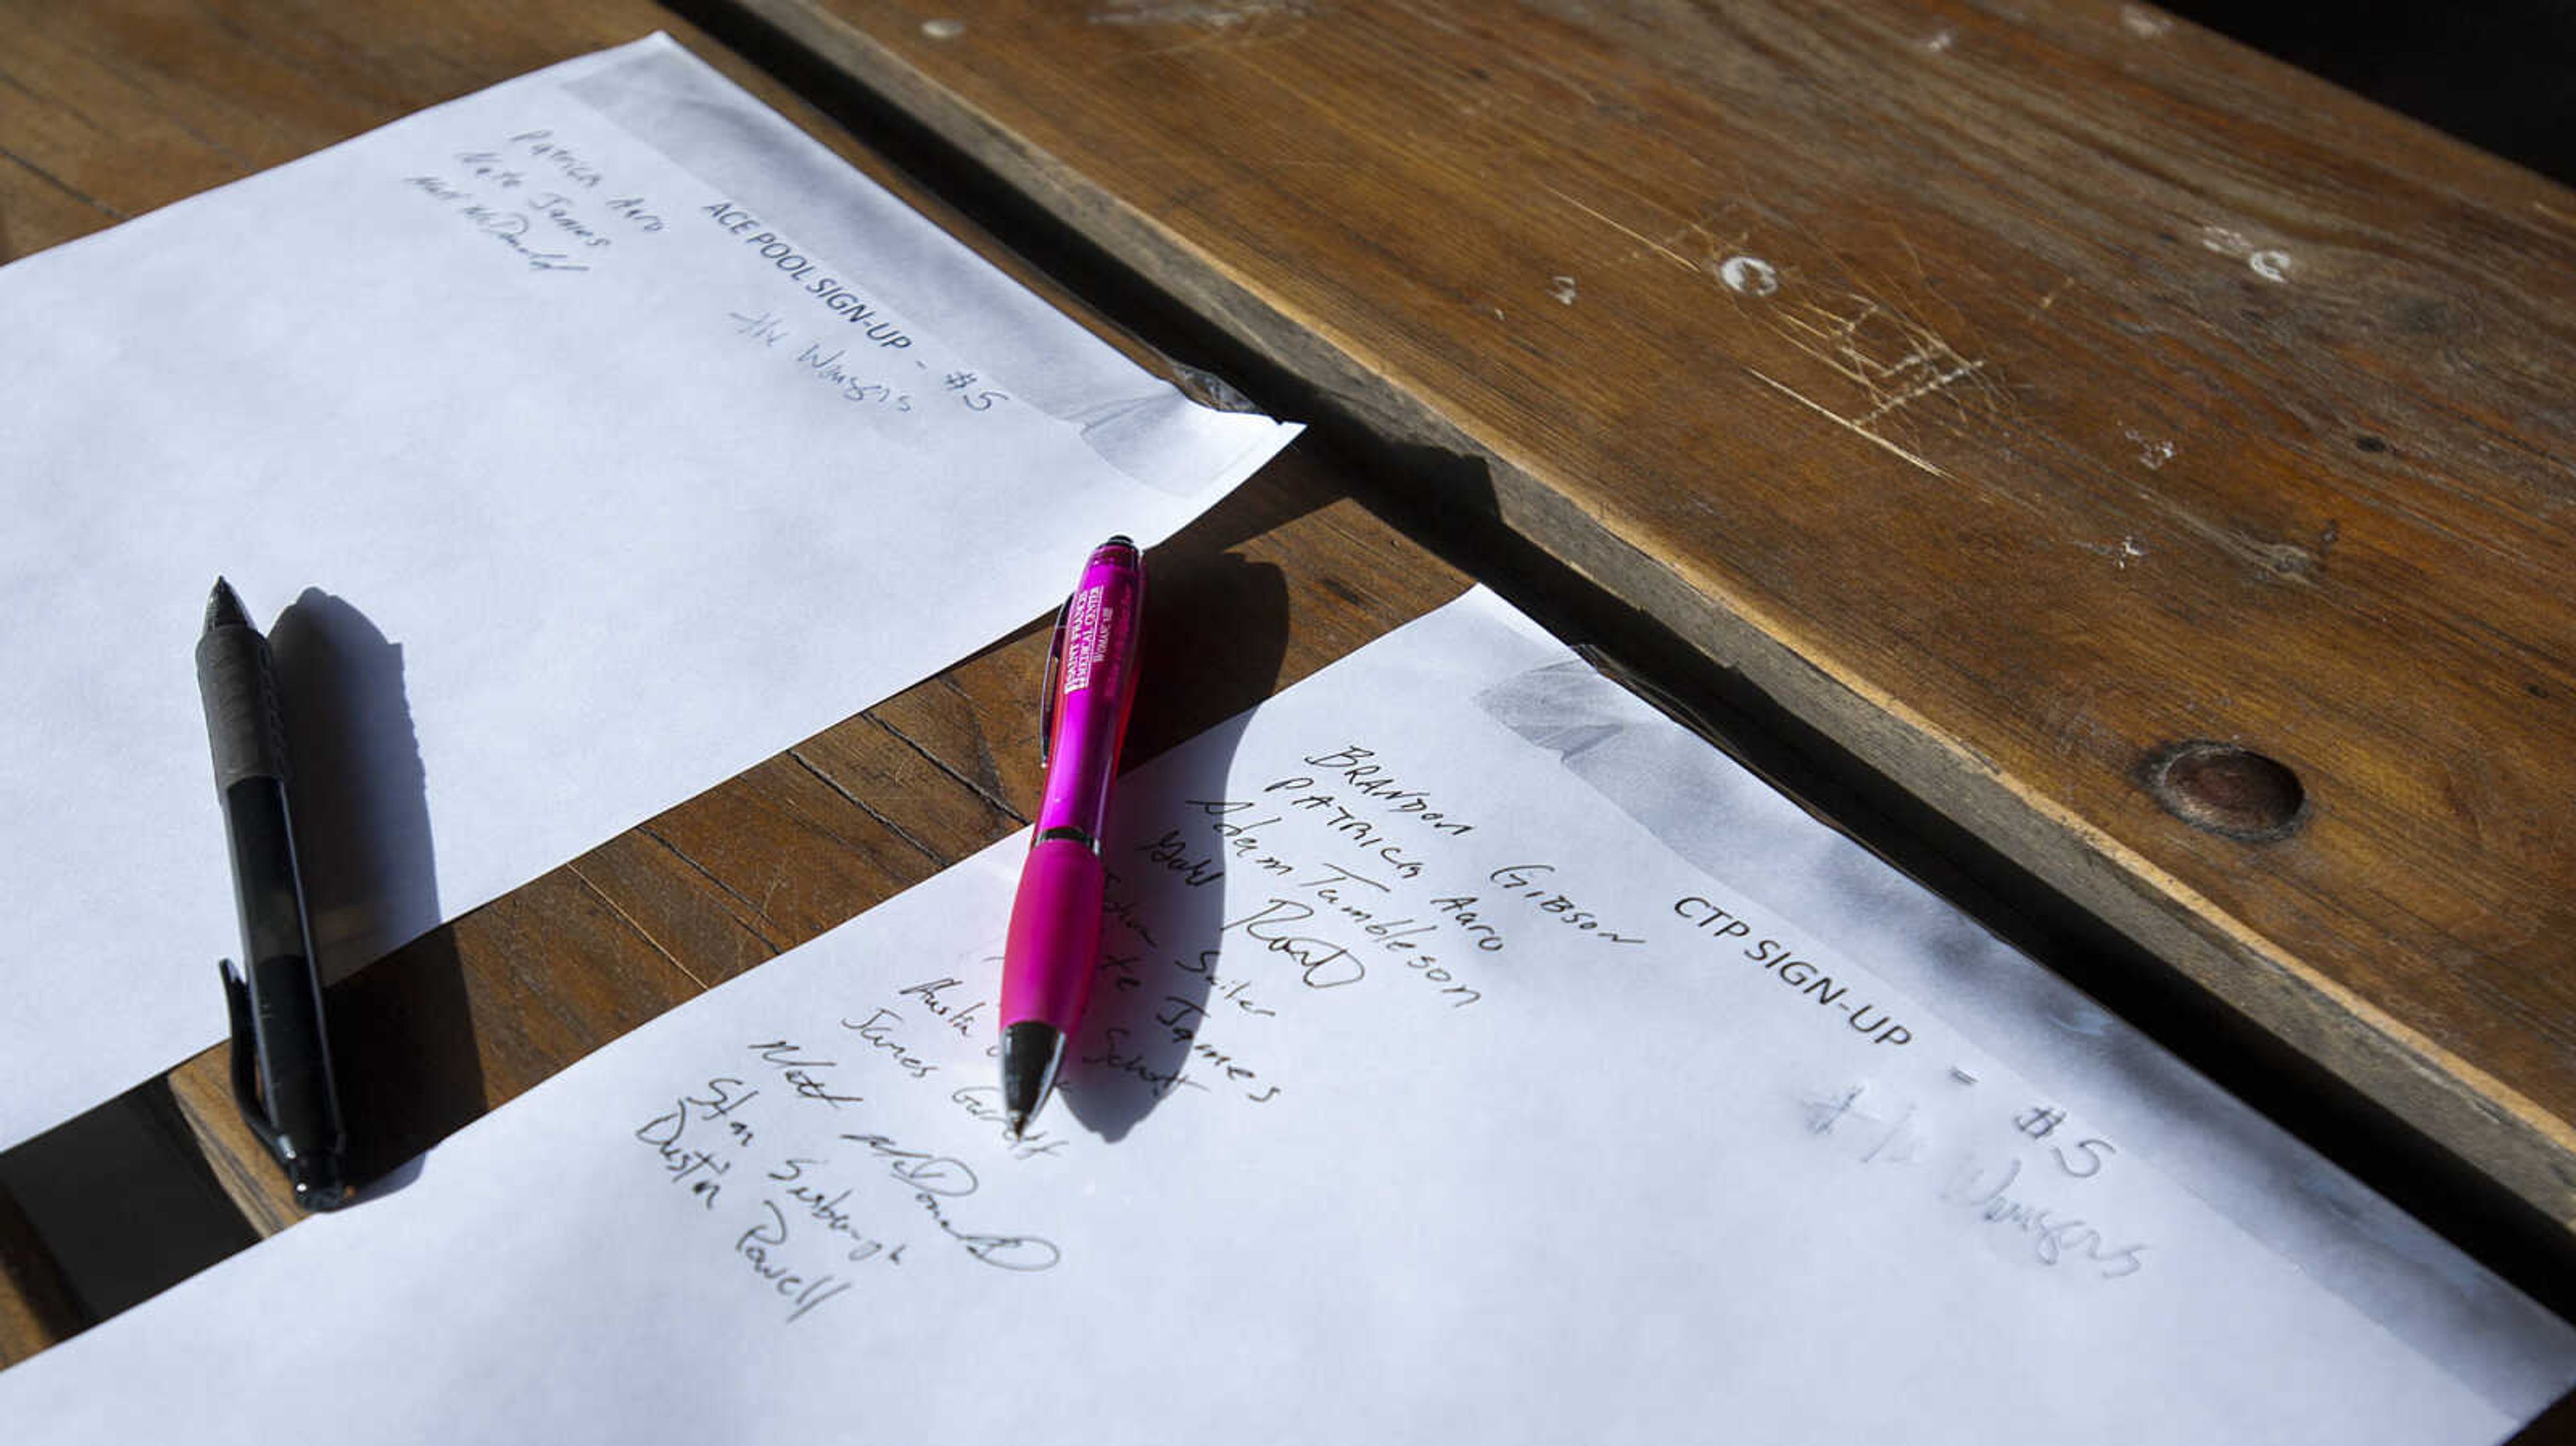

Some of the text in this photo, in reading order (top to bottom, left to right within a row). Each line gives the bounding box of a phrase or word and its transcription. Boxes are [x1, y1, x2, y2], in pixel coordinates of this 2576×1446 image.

[703, 201, 913, 350] ACE POOL SIGN-UP
[1673, 896, 1912, 1047] CTP SIGN-UP
